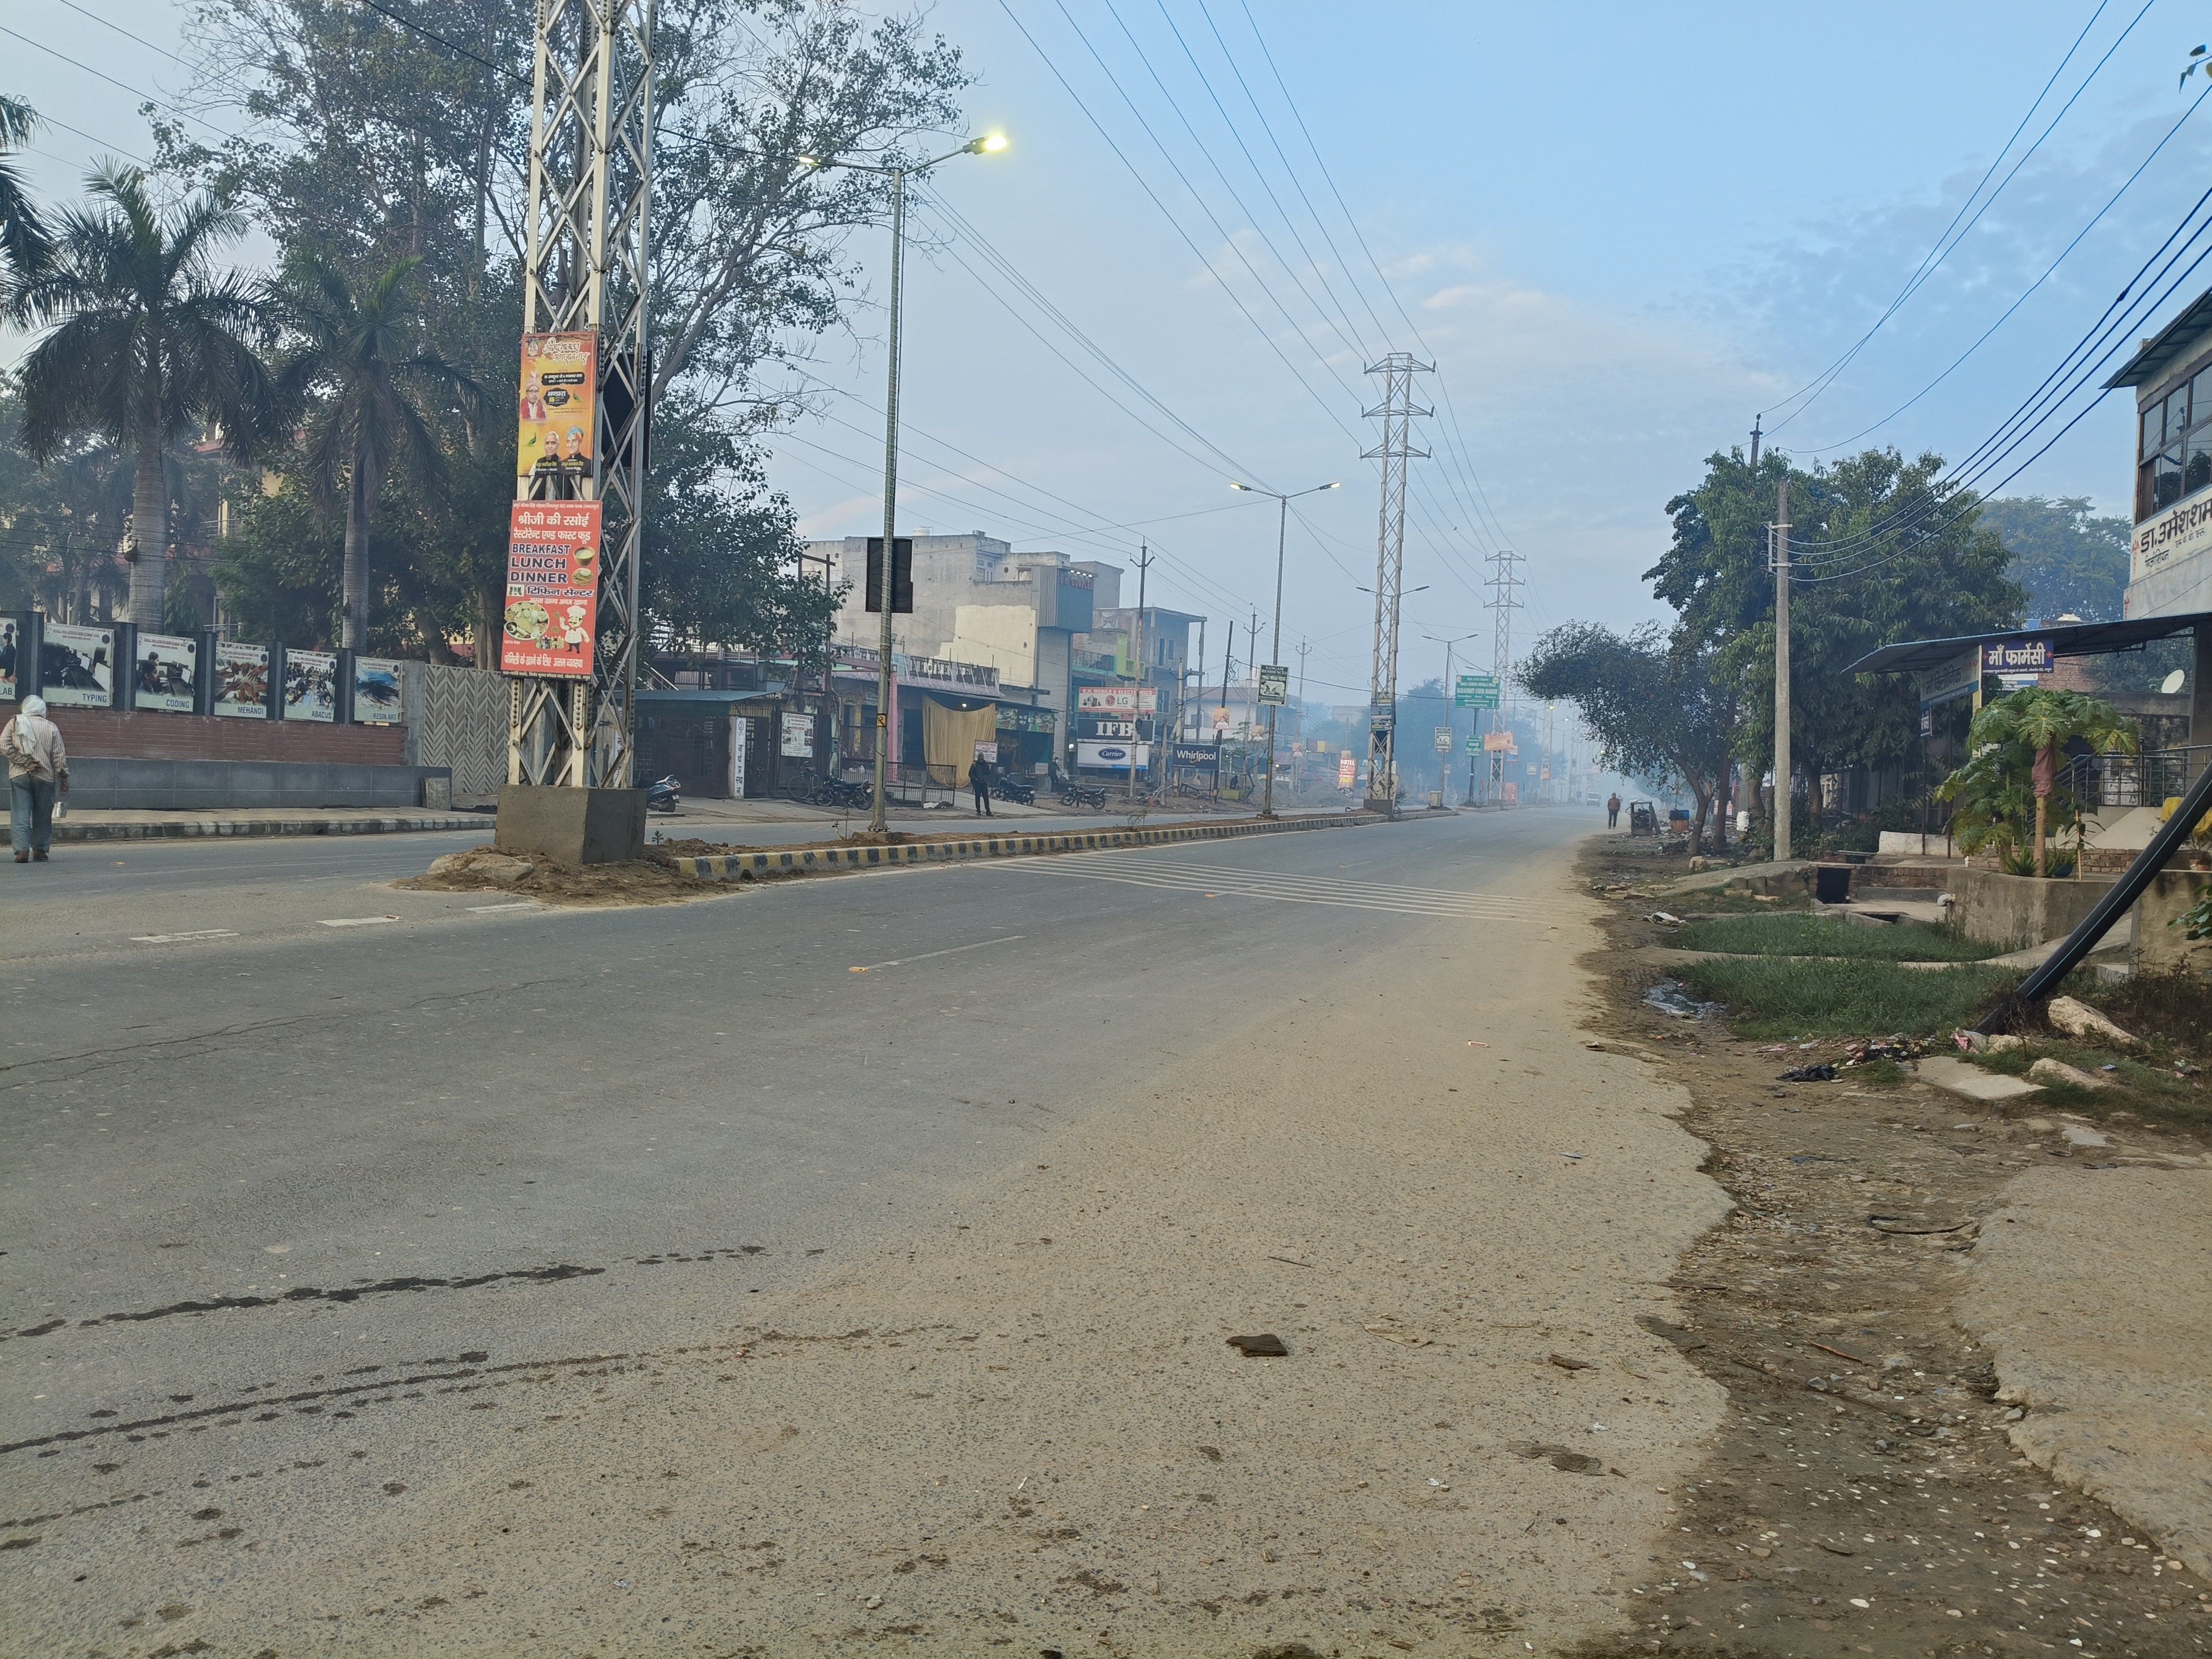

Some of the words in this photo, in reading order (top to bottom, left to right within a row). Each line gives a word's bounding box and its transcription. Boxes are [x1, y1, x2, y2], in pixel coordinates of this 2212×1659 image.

[518, 511, 544, 525] श्रीजी
[547, 512, 561, 525] की
[563, 512, 590, 527] रसोई
[542, 531, 556, 539] एण्ड
[558, 531, 577, 539] फास्ट
[578, 531, 591, 544] फूड
[512, 544, 570, 555] BREAKFAST
[511, 557, 566, 569] LUNCH
[510, 571, 568, 583] DINNER
[527, 586, 561, 595] टिफिन
[563, 587, 594, 596] सेन्टर
[520, 653, 525, 665] के
[537, 654, 542, 665] के
[1988, 644, 2004, 665] माँ
[2005, 642, 2046, 665] फार्मेसी
[82, 693, 107, 702] TYPING
[166, 699, 190, 708] CODING
[238, 706, 264, 714] MEHANDI
[311, 711, 332, 719] ABACUS
[1096, 721, 1133, 736] IFB
[1177, 750, 1216, 762] Whirlpool
